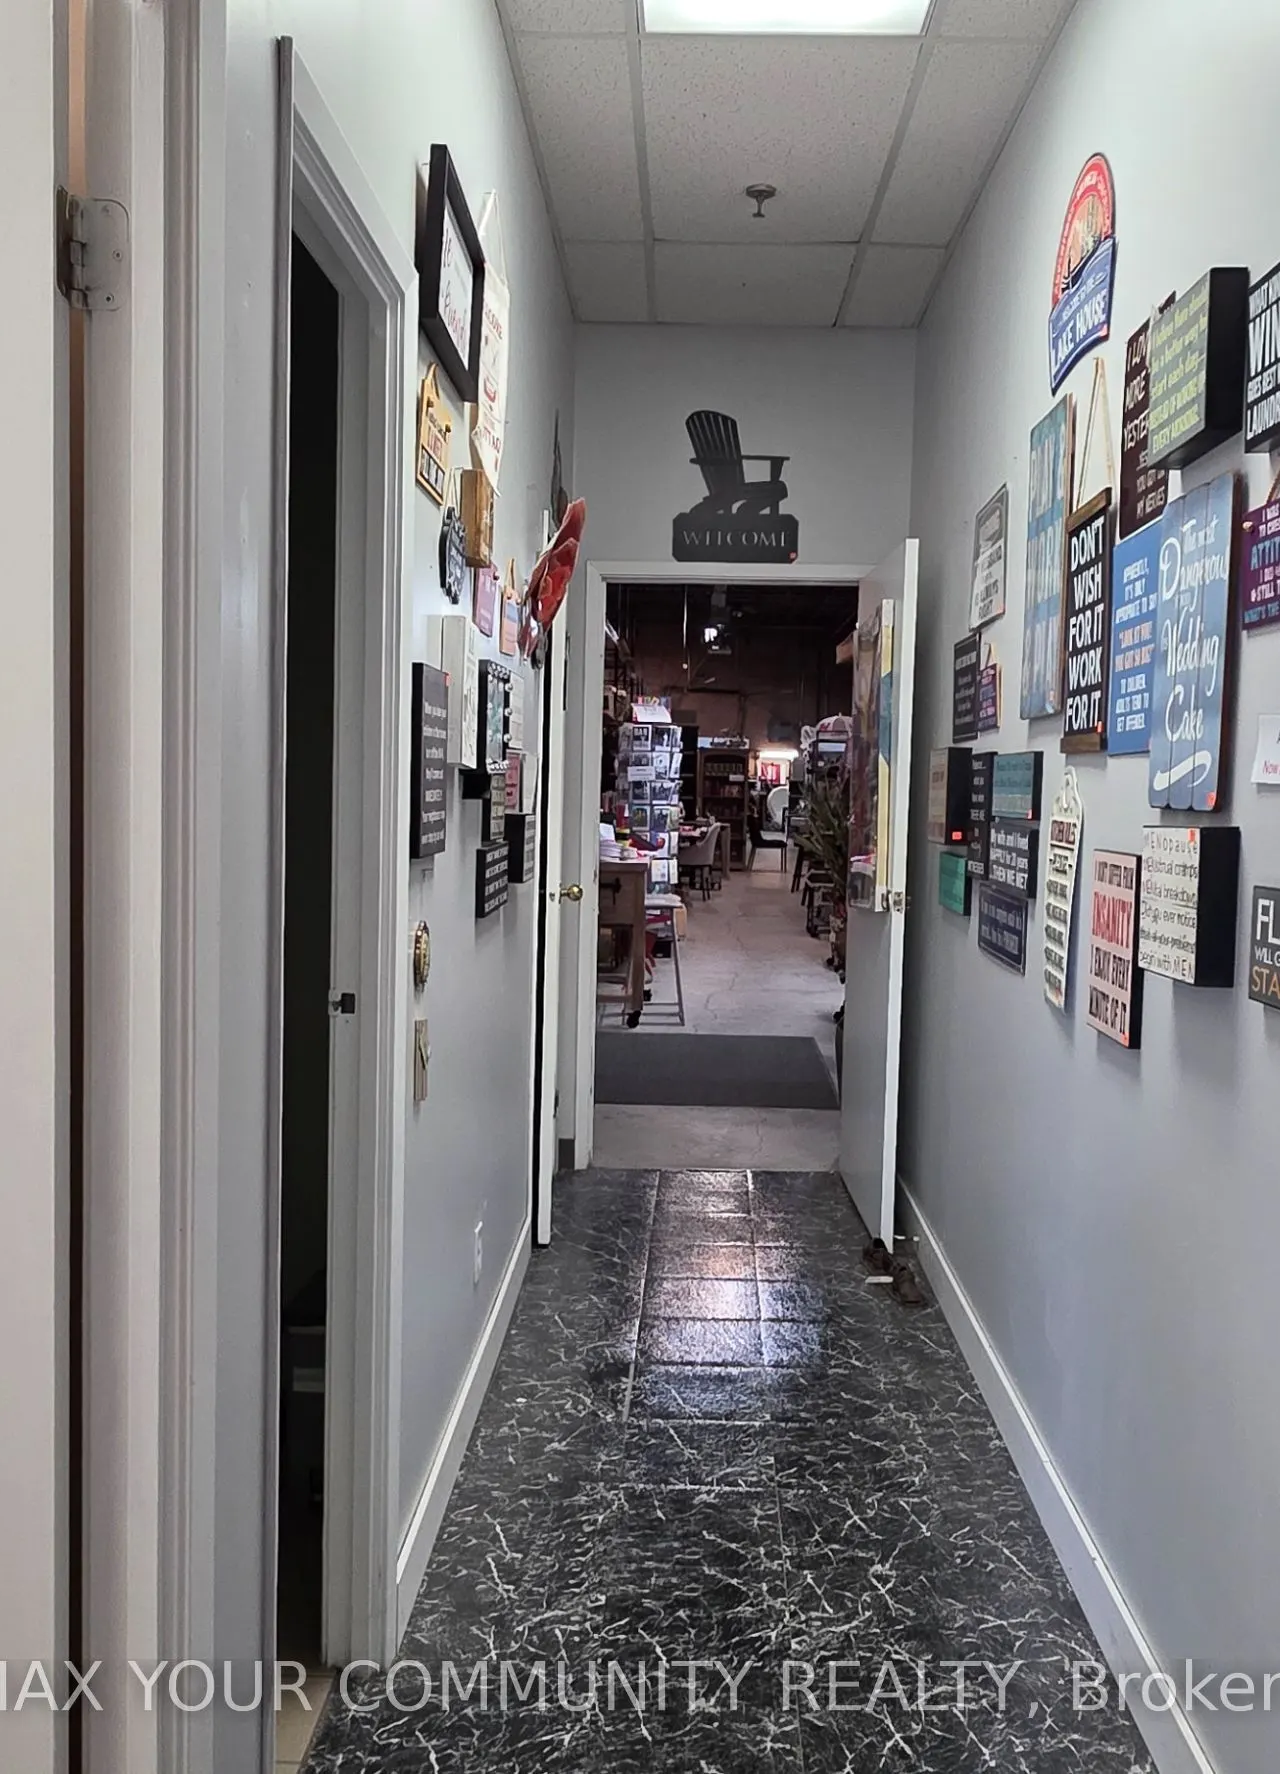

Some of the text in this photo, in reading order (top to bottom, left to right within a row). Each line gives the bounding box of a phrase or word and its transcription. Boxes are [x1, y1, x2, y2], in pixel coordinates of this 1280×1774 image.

[1053, 320, 1074, 376] LAKE
[1076, 288, 1108, 343] HOUSE
[1125, 369, 1147, 412] MORE
[1124, 408, 1149, 451] YESTE
[1071, 515, 1104, 572] DON'T
[1074, 561, 1103, 610] WISH
[1069, 602, 1104, 652] FOR IT
[1069, 646, 1103, 691] WORK
[1161, 606, 1219, 697] Wedding
[1065, 694, 1090, 732] FOR
[1165, 684, 1204, 742] Cake
[1263, 760, 1277, 775] Now
[1092, 891, 1132, 948] INSANITY
[1094, 946, 1111, 982] ENJOY
[1111, 954, 1130, 991] EVERY
[1254, 945, 1273, 965] WILL
